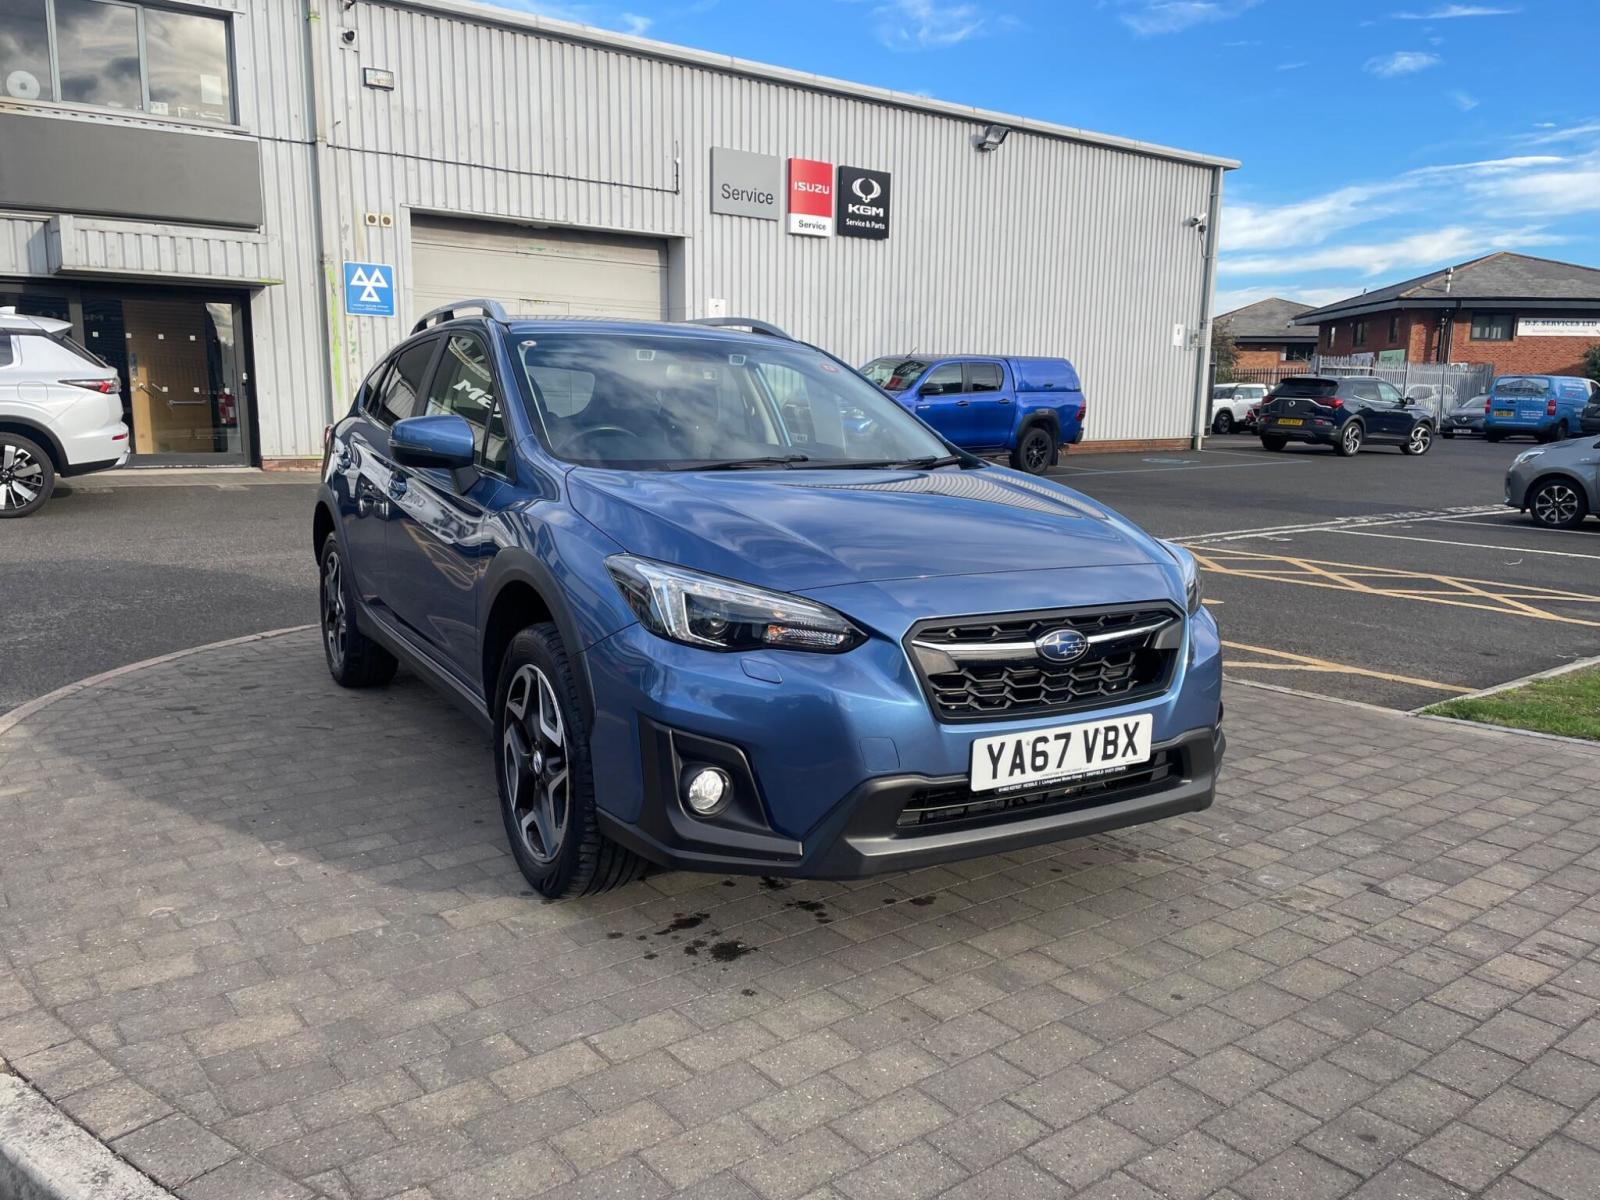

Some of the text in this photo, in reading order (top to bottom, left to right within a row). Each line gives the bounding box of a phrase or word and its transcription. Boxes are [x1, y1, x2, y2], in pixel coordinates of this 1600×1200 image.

[721, 183, 774, 205] Service
[793, 181, 830, 195] ISUZU
[847, 203, 884, 218] KGM
[798, 219, 827, 231] Service
[846, 218, 865, 228] Service
[871, 221, 886, 230] Parts
[986, 721, 1140, 780] YA67 VBX
